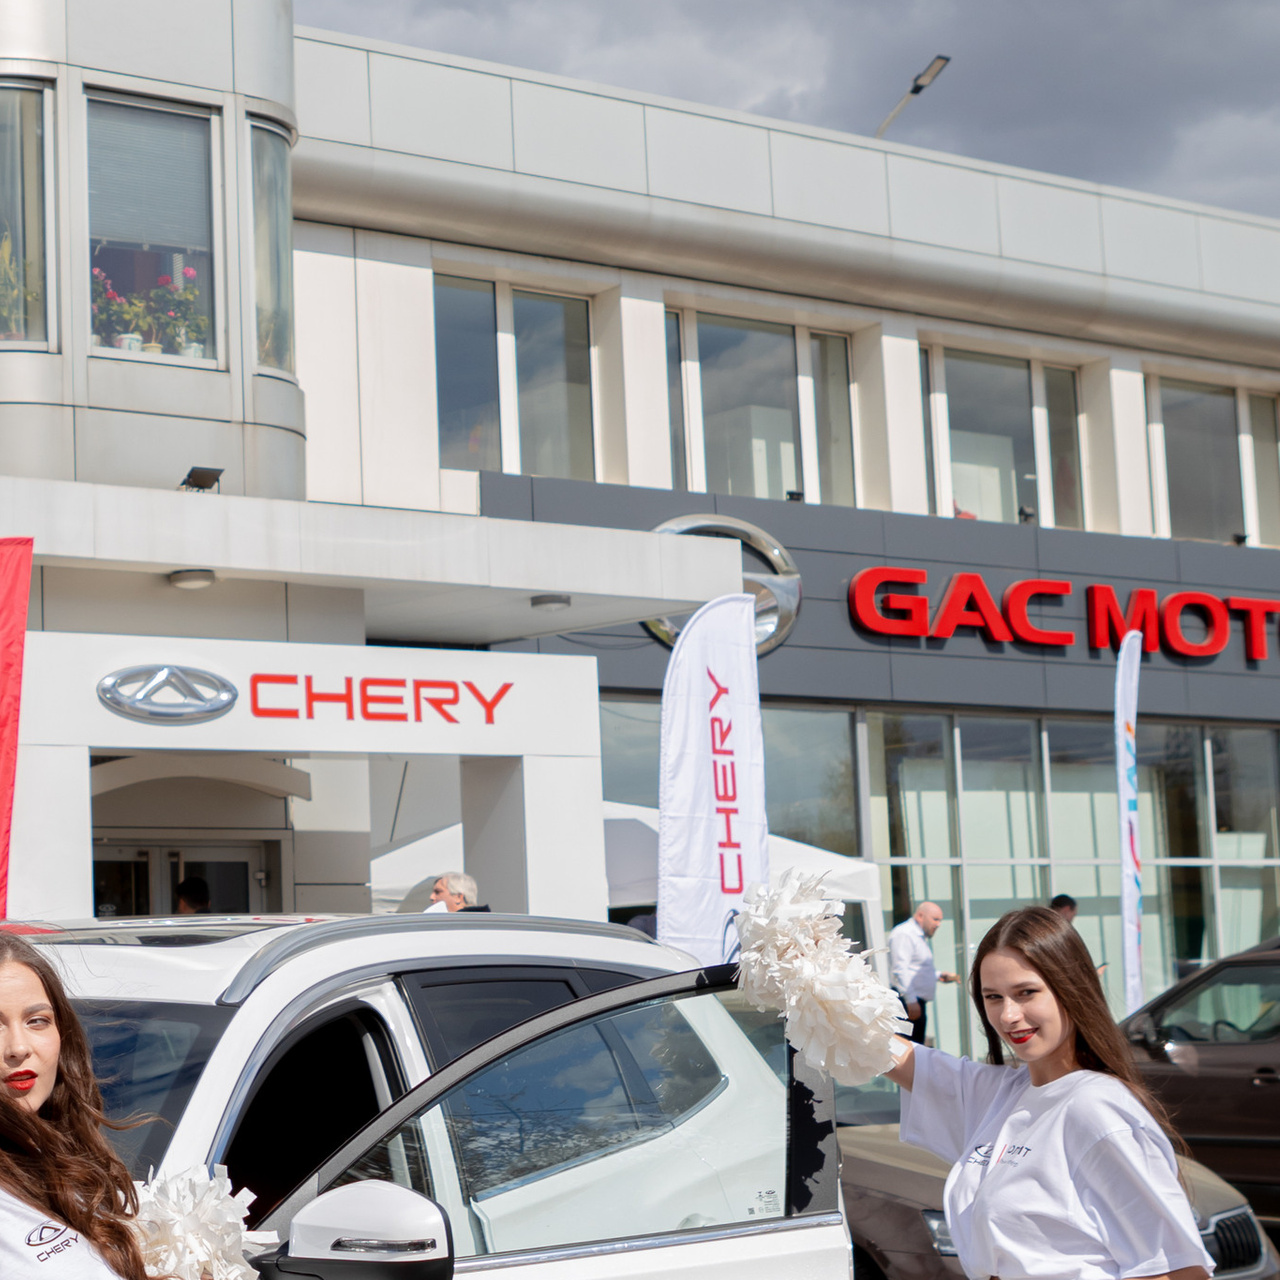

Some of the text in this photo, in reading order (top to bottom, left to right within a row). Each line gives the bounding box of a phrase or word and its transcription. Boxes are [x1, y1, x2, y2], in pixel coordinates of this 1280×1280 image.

[848, 565, 1076, 647] GAC
[249, 673, 515, 725] CHERY
[707, 665, 744, 895] CHERY
[36, 1233, 79, 1263] CHERY
